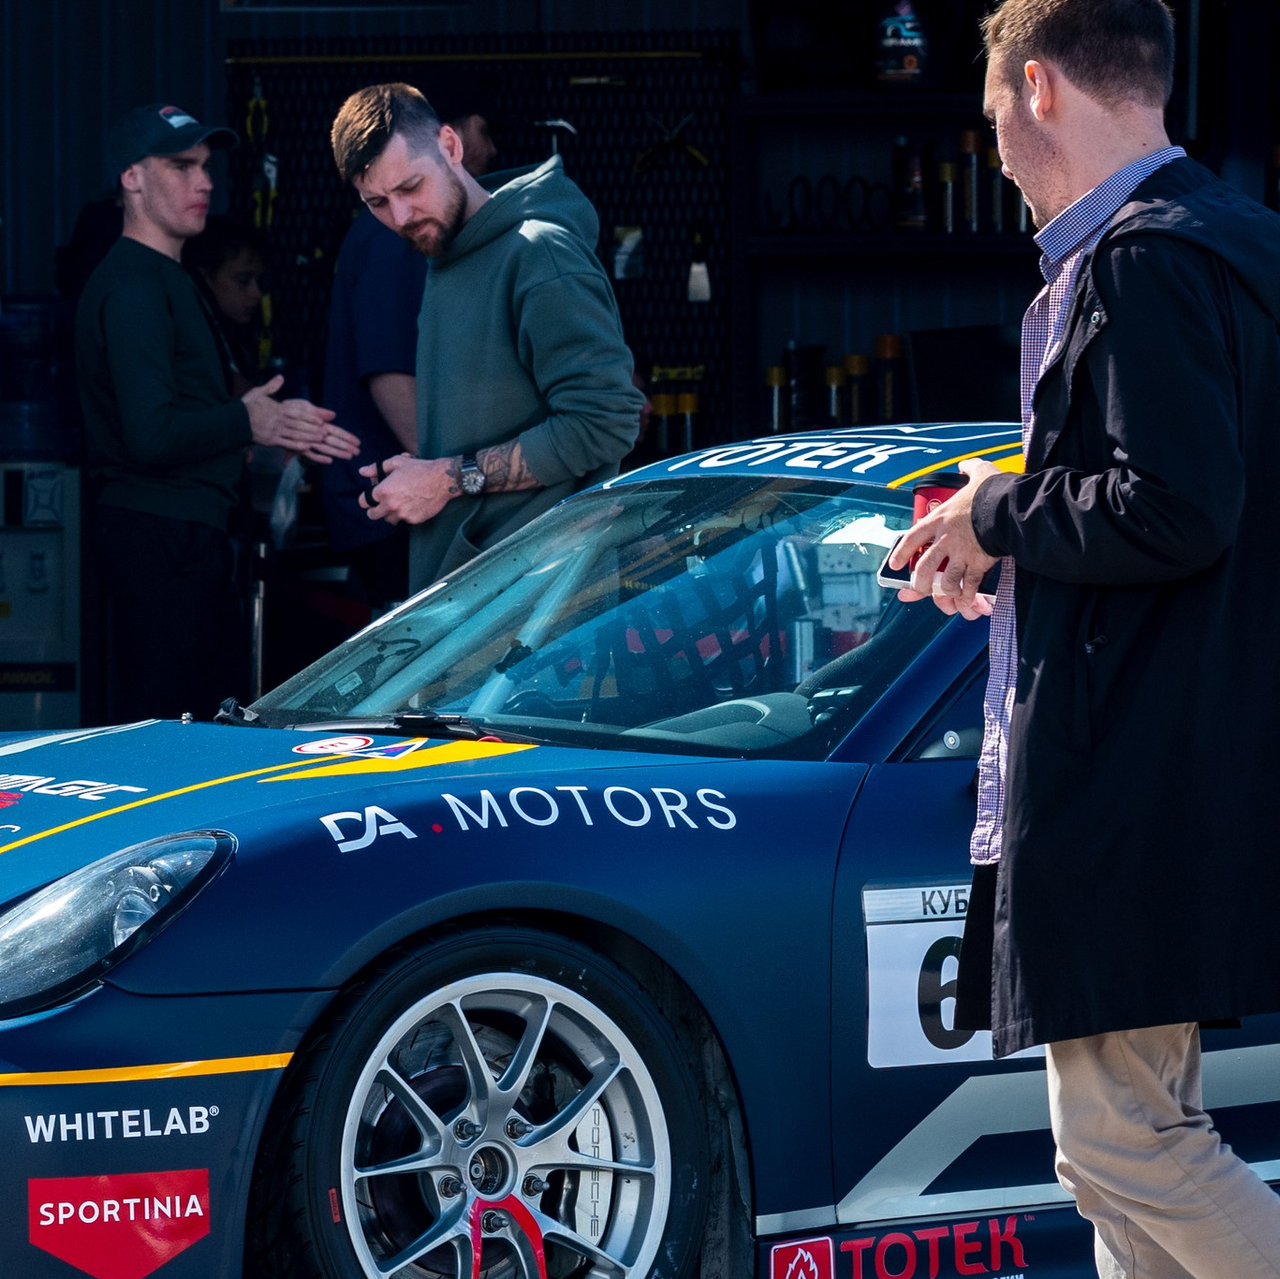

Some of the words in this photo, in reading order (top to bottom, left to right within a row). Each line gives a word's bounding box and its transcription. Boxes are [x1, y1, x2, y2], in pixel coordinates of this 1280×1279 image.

[440, 786, 737, 831] MOTORS
[921, 889, 969, 916] КУБ
[39, 1194, 204, 1226] SPORTINIA
